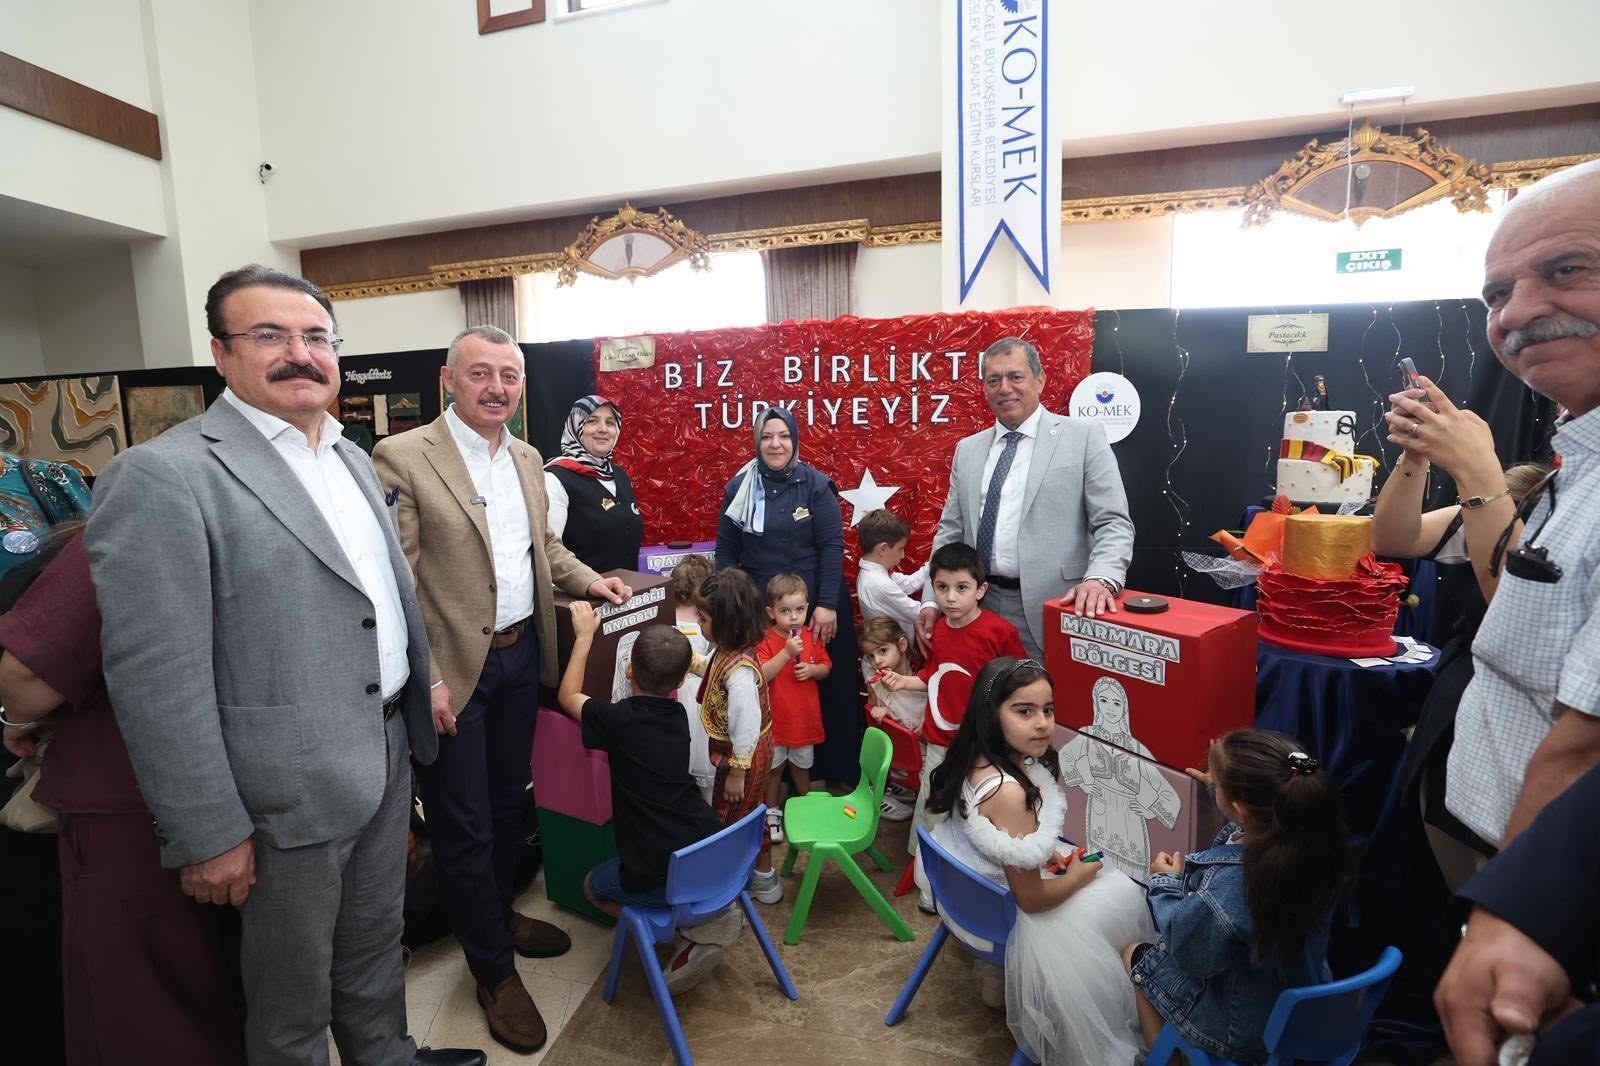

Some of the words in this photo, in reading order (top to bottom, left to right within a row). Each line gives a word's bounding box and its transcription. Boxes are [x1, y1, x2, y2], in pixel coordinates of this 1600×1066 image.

[969, 0, 980, 33] ESLEK
[984, 0, 997, 41] CAELİ
[970, 54, 981, 97] SANAT
[1001, 15, 1038, 203] KO-MEK
[971, 150, 982, 207] KURSLARI
[1345, 260, 1392, 272] ÇIKIŞ
[1350, 250, 1388, 261] EXIT
[664, 354, 734, 389] BİZ
[1078, 404, 1132, 417] KO-MEK
[603, 607, 658, 635] ANADOLU
[1062, 614, 1179, 661] MARMARA
[1072, 642, 1164, 684] BÖLGESİ
